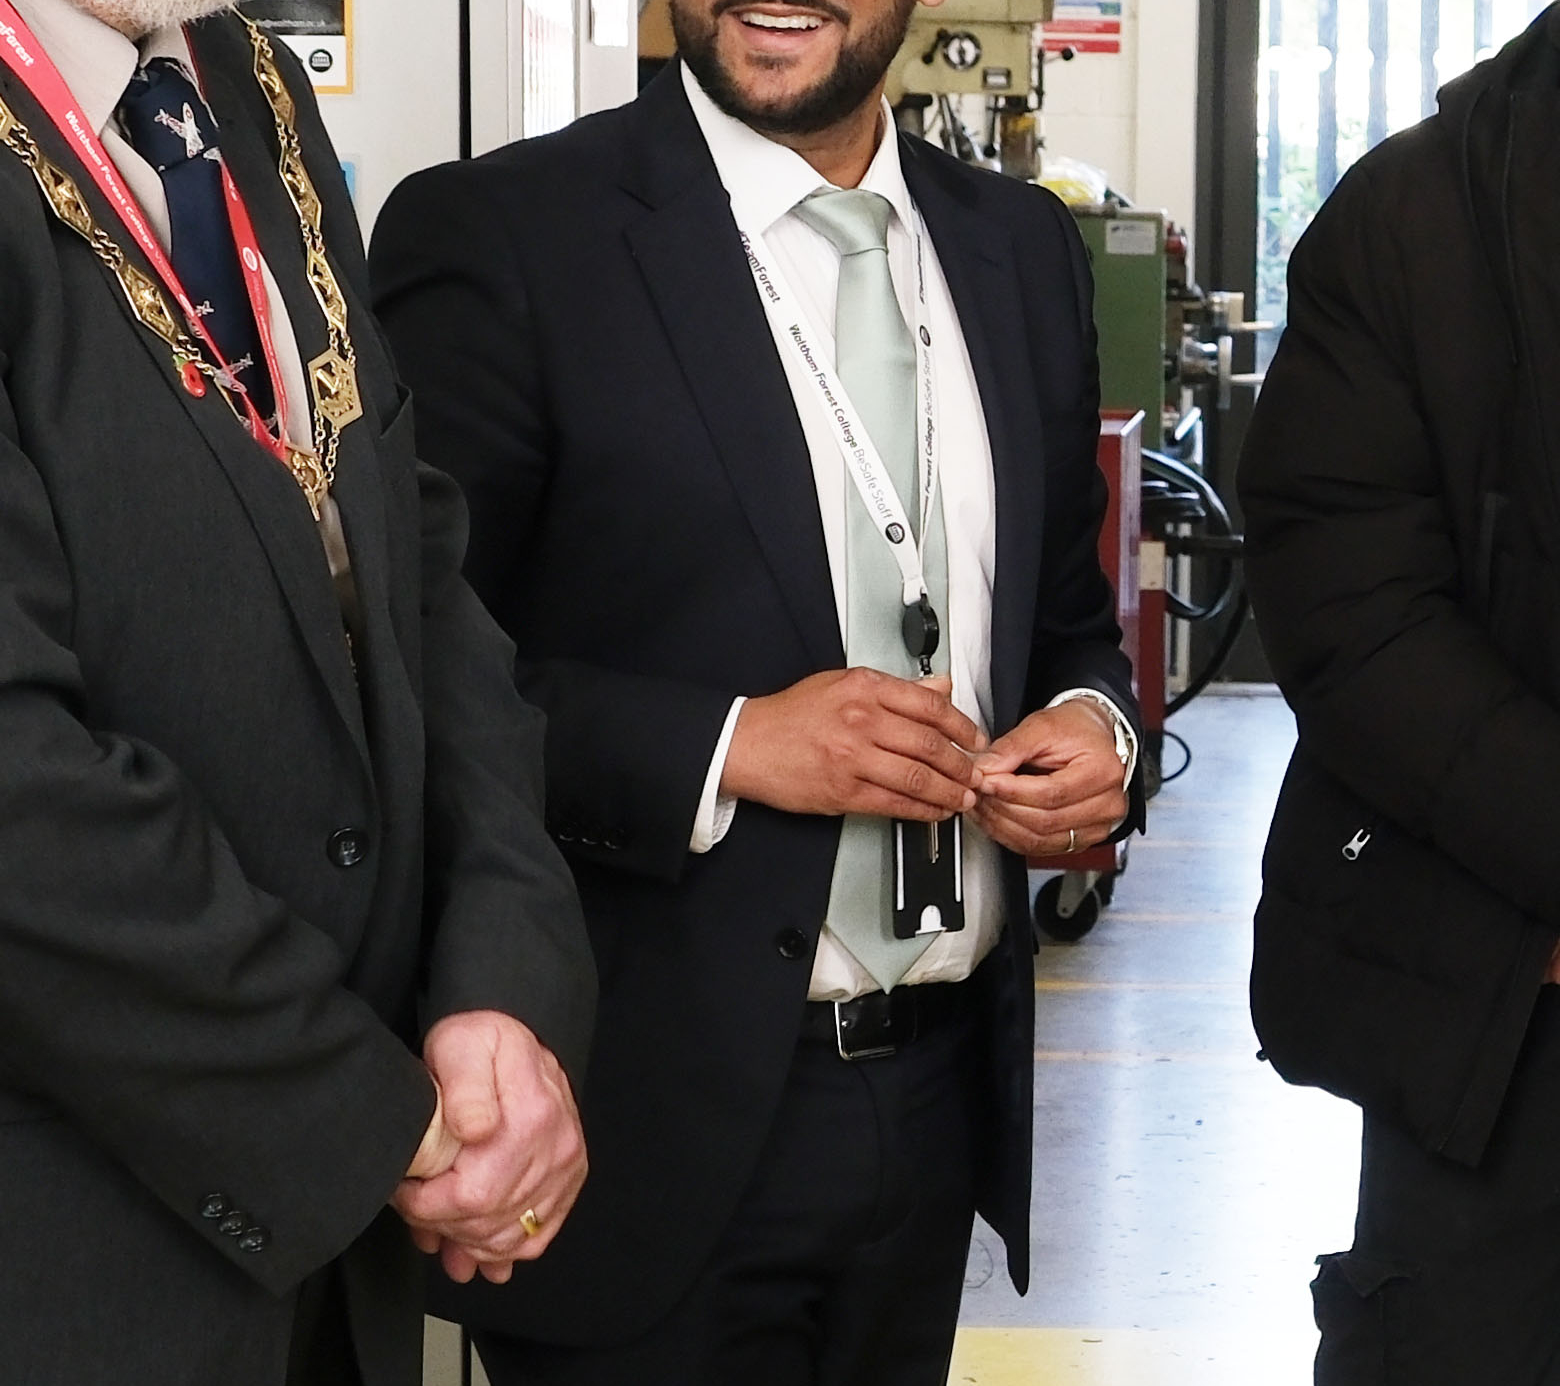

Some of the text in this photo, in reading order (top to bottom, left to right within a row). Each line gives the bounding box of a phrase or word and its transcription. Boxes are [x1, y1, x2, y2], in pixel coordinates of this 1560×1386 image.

[788, 322, 819, 373] Waltham
[814, 371, 839, 409] Forest
[833, 406, 859, 449] College
